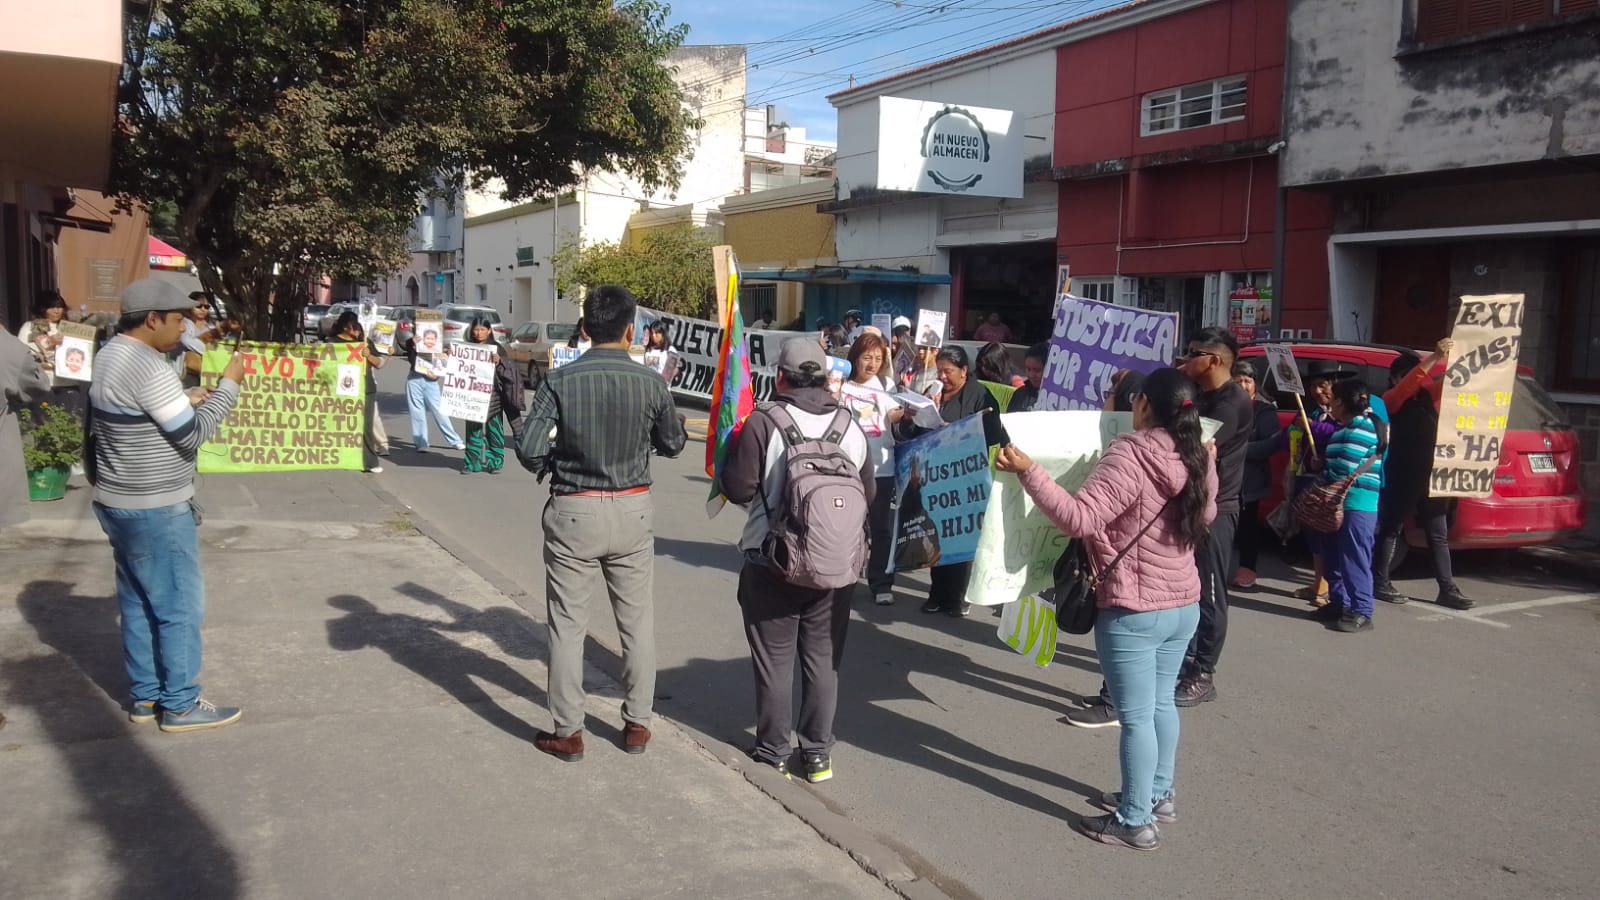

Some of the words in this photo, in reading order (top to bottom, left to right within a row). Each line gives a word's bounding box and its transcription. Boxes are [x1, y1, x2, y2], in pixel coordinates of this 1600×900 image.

[934, 133, 944, 144] MI
[947, 135, 978, 147] NUEVO
[933, 145, 978, 160] ALMACEN
[243, 354, 294, 378] IVO
[1043, 344, 1081, 391] POR
[444, 372, 466, 389] IVO
[282, 396, 308, 412] NO
[311, 397, 364, 415] APAGA
[225, 410, 300, 429] BRILLO
[306, 415, 327, 430] DE
[333, 415, 357, 431] TU
[260, 429, 284, 447] EN
[292, 431, 363, 448] NUESTRO
[230, 446, 339, 464] CORAZONES
[920, 452, 989, 487] JUSTICIA
[927, 489, 961, 511] POR
[966, 483, 986, 503] MI
